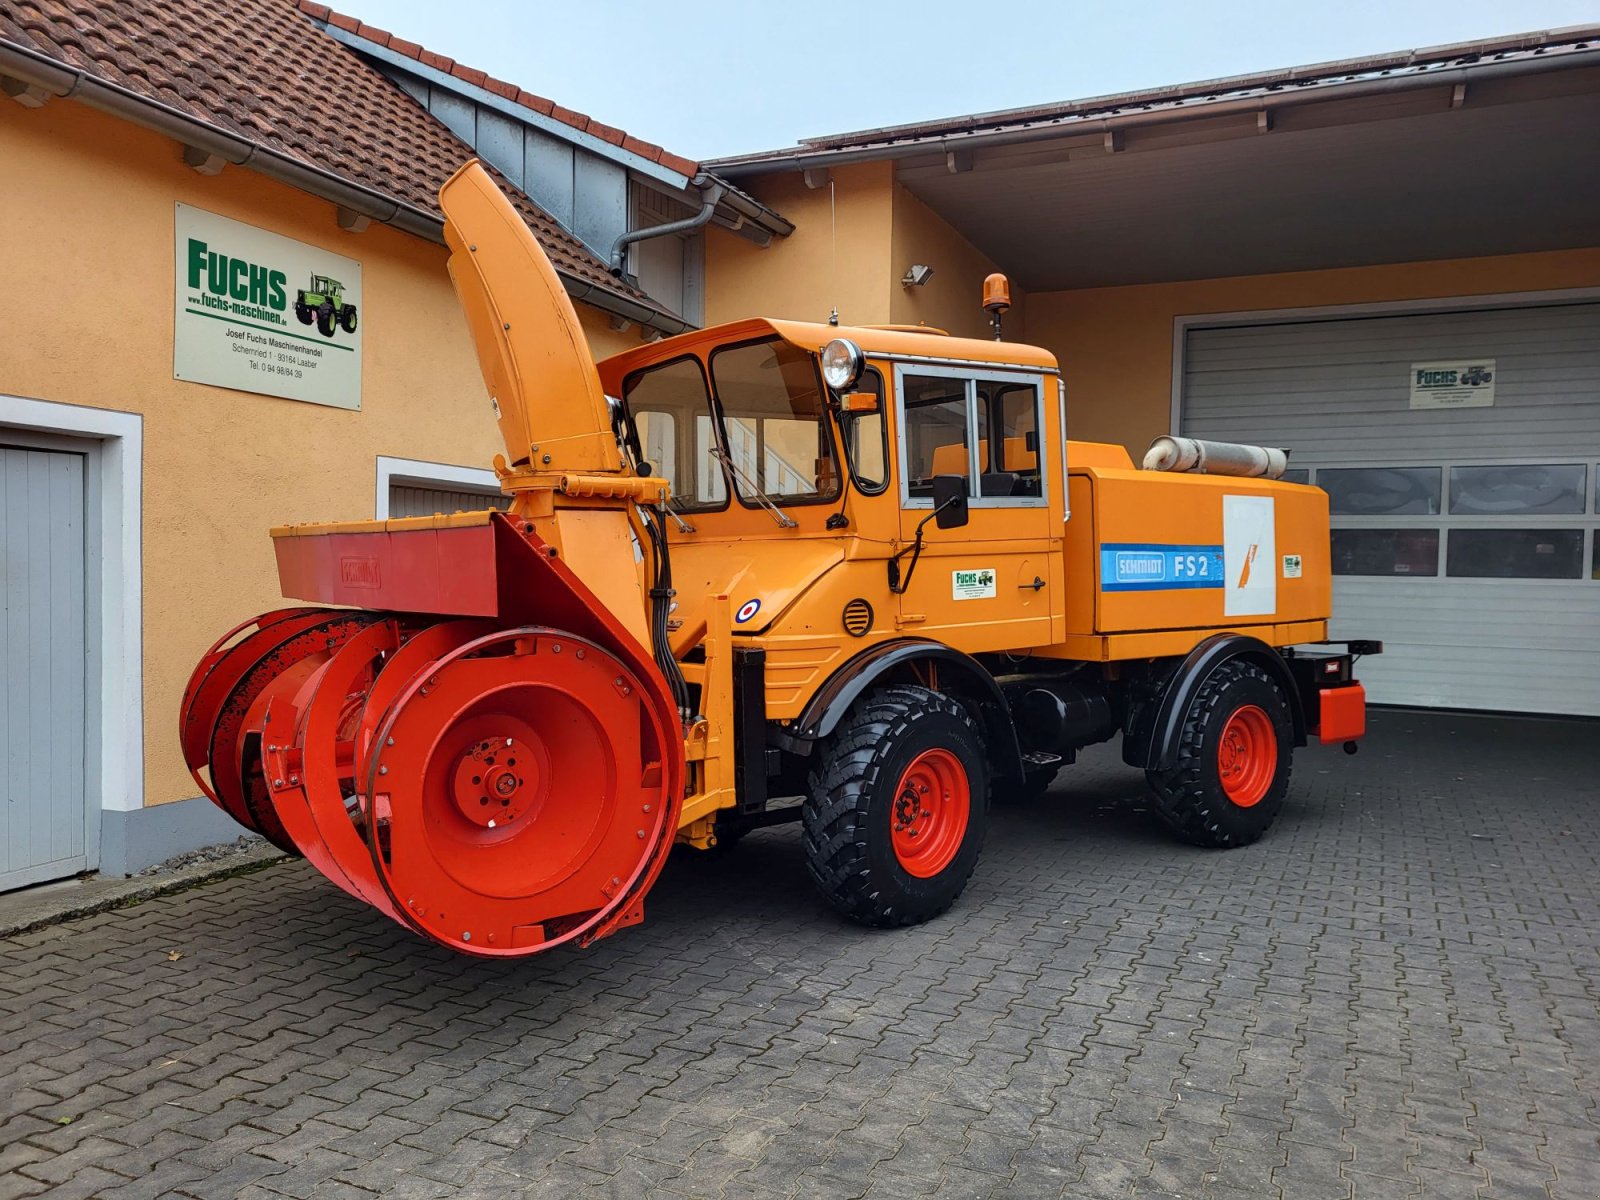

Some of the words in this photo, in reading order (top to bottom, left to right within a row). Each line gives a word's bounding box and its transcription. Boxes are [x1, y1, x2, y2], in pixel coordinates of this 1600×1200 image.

[188, 238, 287, 312] FUCHS
[188, 292, 287, 326] www.fuchs-maschinen.de
[225, 328, 245, 340] Josef
[246, 332, 267, 345] Fuchs
[269, 337, 323, 357] Maschinenhandel
[267, 364, 275, 373] 94
[277, 353, 296, 364] 93164
[297, 357, 317, 369] Laaber
[1416, 370, 1458, 385] FUCHS
[1120, 559, 1162, 574] SCHMIDT
[956, 572, 977, 584] FUCHS
